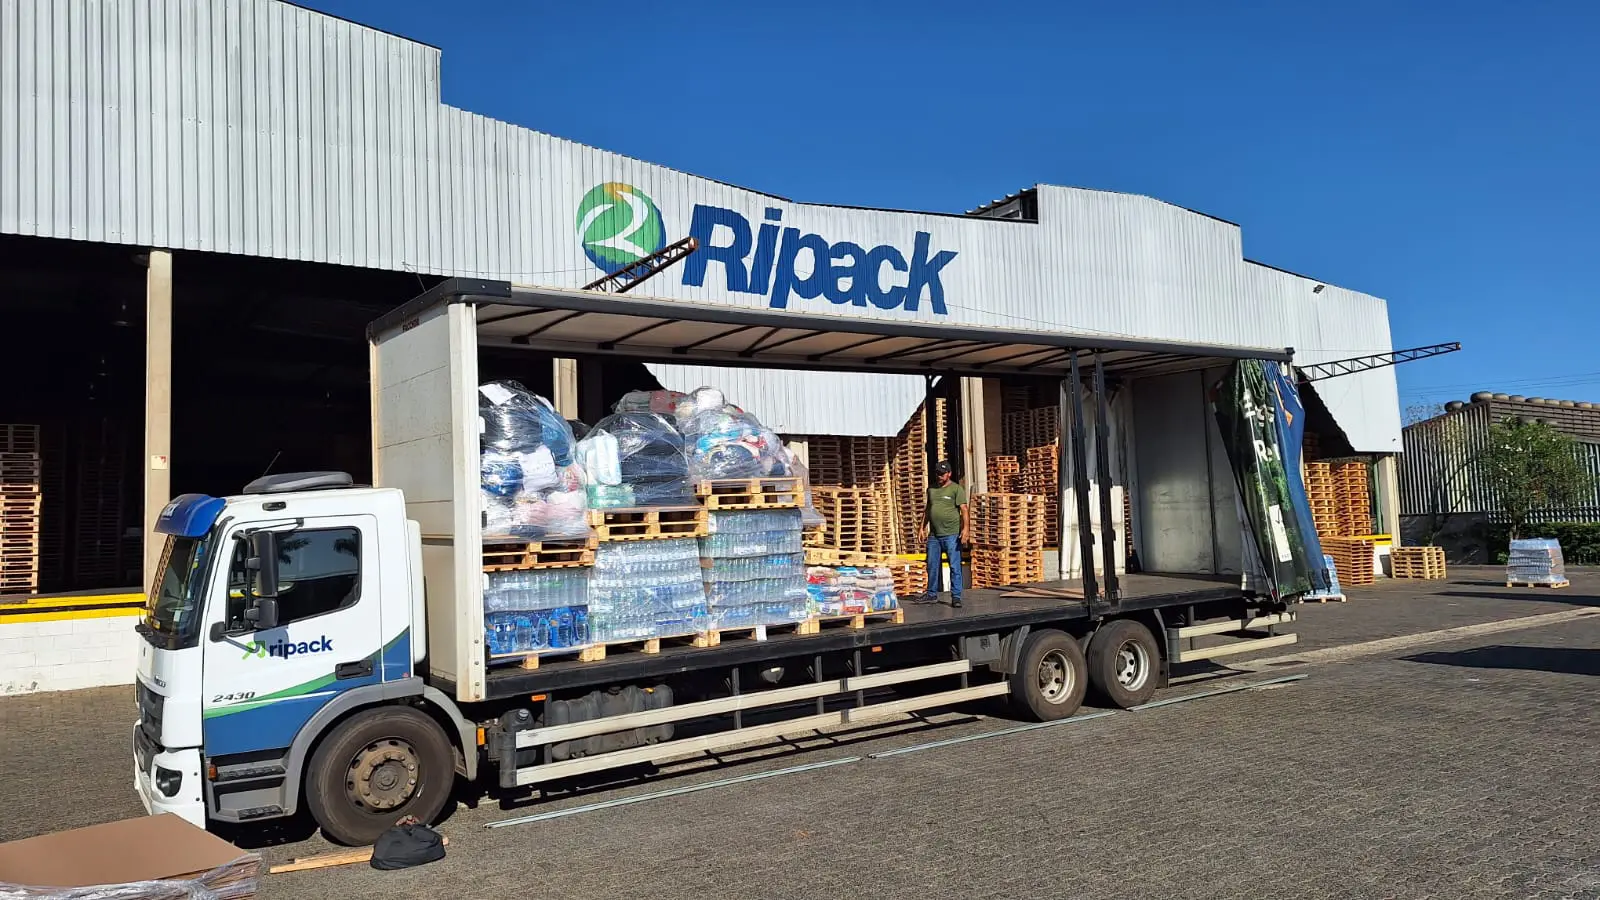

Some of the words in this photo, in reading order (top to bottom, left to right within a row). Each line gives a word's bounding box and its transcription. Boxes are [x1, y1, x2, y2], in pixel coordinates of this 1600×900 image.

[682, 204, 958, 315] Ripack
[269, 635, 333, 660] ripack
[212, 691, 256, 703] 2430
